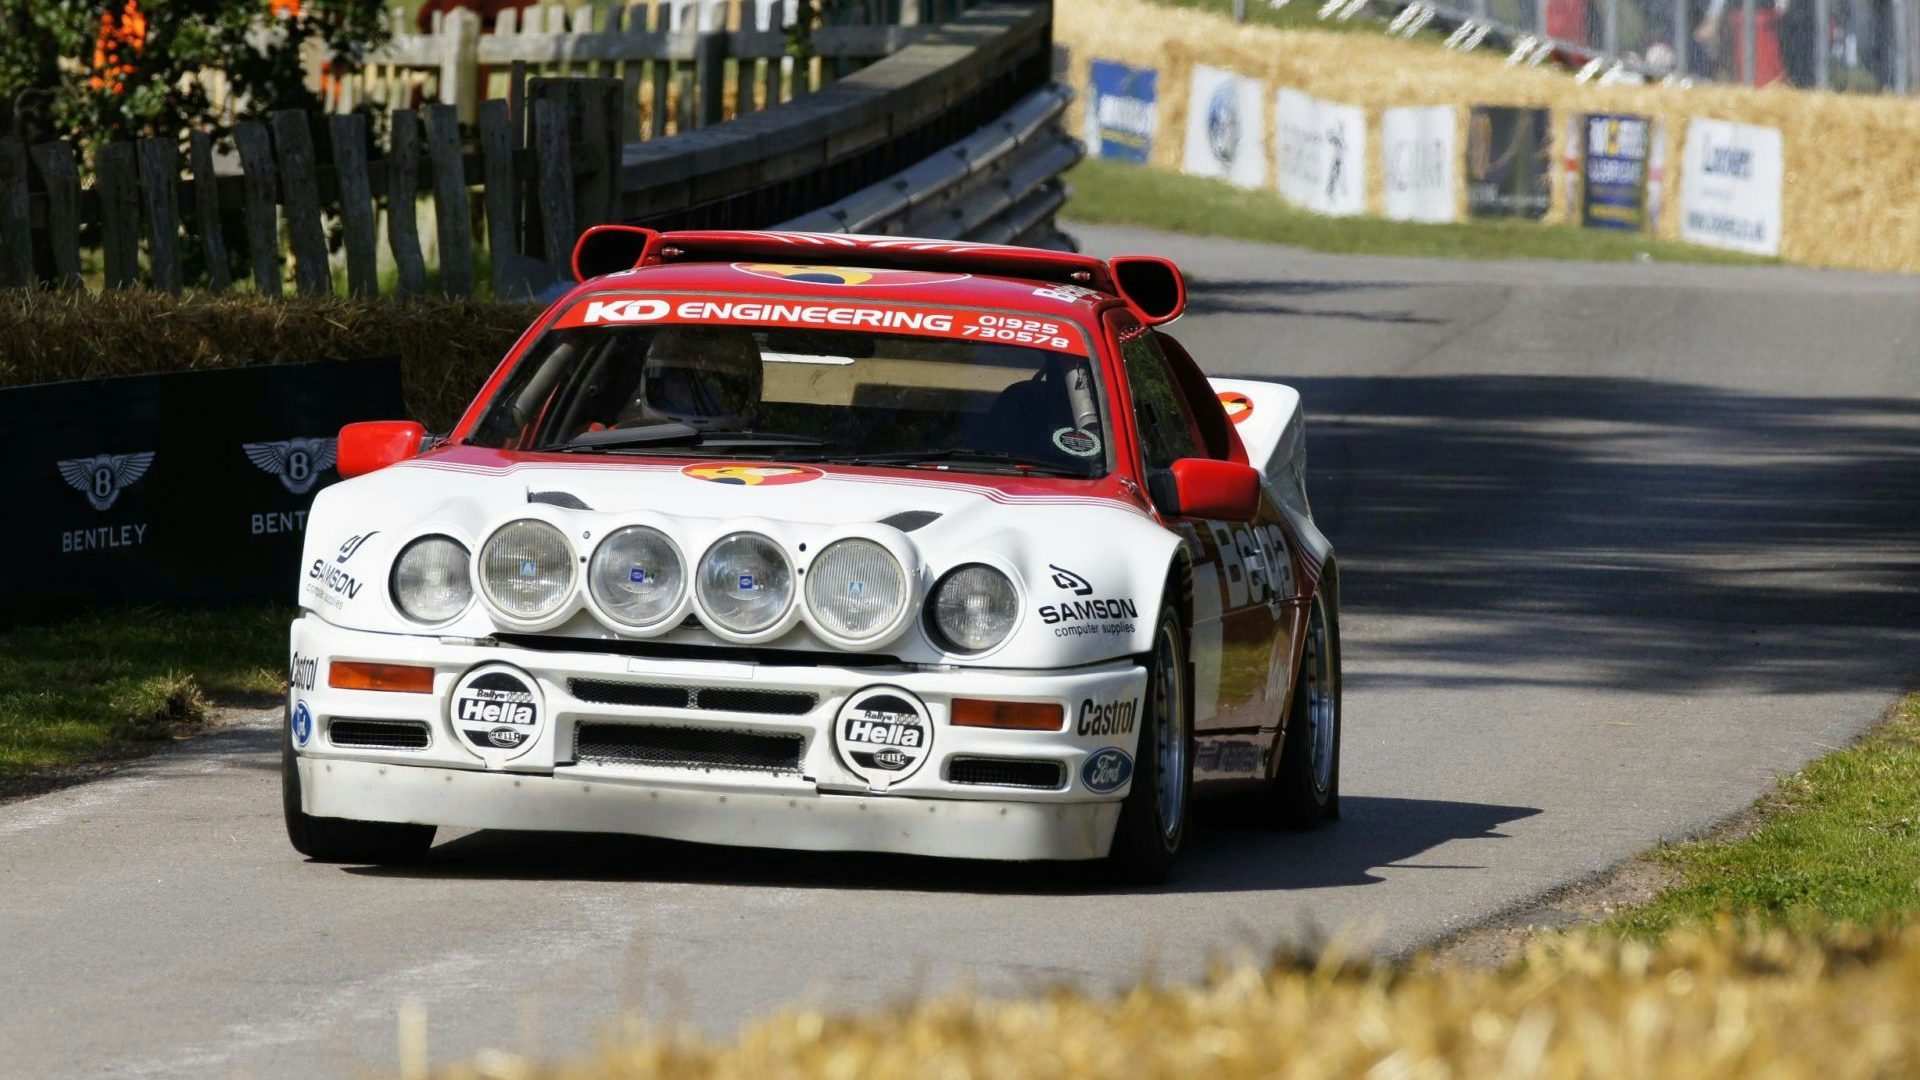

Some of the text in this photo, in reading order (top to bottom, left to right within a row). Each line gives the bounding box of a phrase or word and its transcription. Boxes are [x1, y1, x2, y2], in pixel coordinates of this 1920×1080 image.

[583, 300, 953, 331] KD ENGINEERING
[978, 315, 1058, 334] 01925
[962, 325, 1069, 348] 730578
[252, 511, 307, 534] BENT
[62, 523, 147, 552] BENTLEY
[309, 559, 363, 599] SAMSON
[1207, 519, 1294, 621] Belga
[1039, 598, 1138, 624] SAMSON
[1055, 622, 1135, 637] computer supplies
[477, 689, 505, 700] Rallye
[462, 699, 533, 724] Hella
[864, 711, 893, 722] Rallye
[1077, 698, 1137, 736] Castrol
[849, 720, 920, 746] Hella
[1091, 754, 1122, 785] Ford
